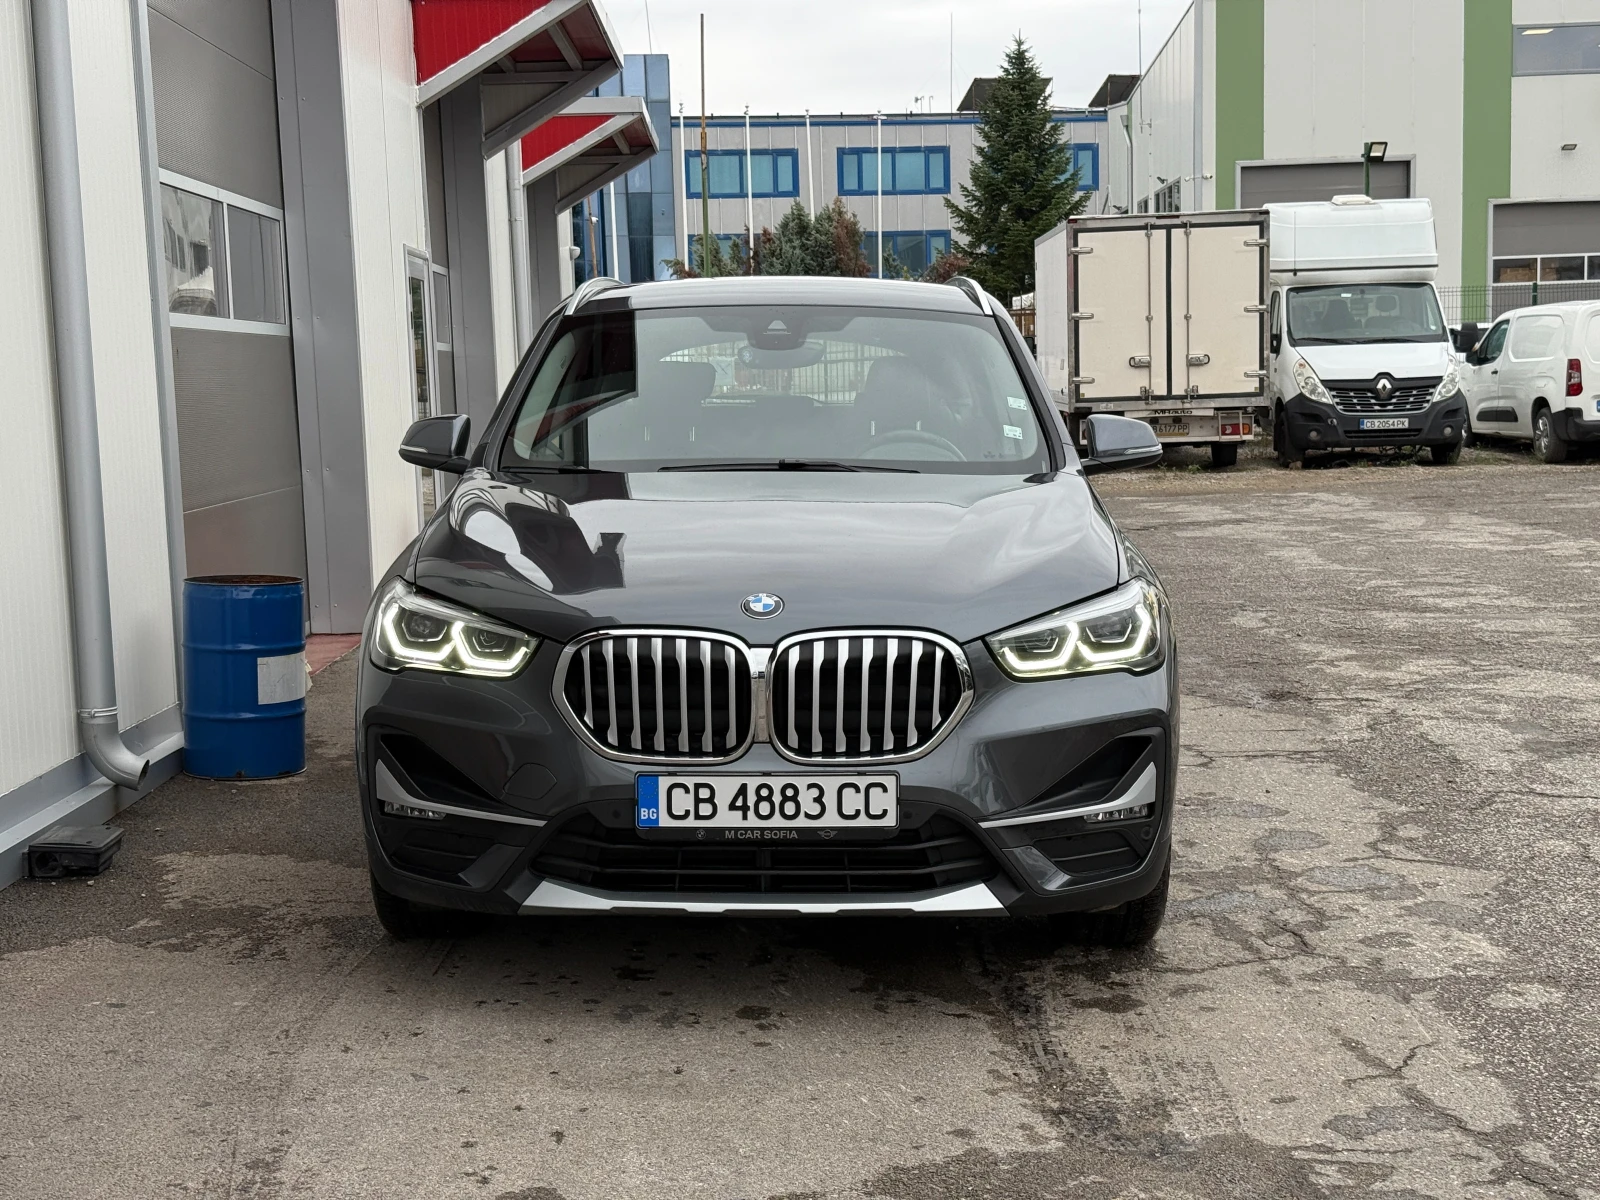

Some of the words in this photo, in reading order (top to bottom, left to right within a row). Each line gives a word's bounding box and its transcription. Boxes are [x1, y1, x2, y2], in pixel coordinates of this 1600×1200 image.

[1159, 424, 1176, 433] 6177
[1178, 424, 1187, 433] PP
[1366, 420, 1376, 429] CB
[1377, 420, 1395, 428] 2054
[1396, 419, 1406, 428] PK
[667, 782, 718, 821] CB
[728, 782, 827, 821] 4883
[836, 782, 889, 821] CC
[640, 807, 658, 820] BG
[725, 830, 735, 839] M
[737, 830, 761, 839] CAR
[763, 830, 798, 839] SOFIA
